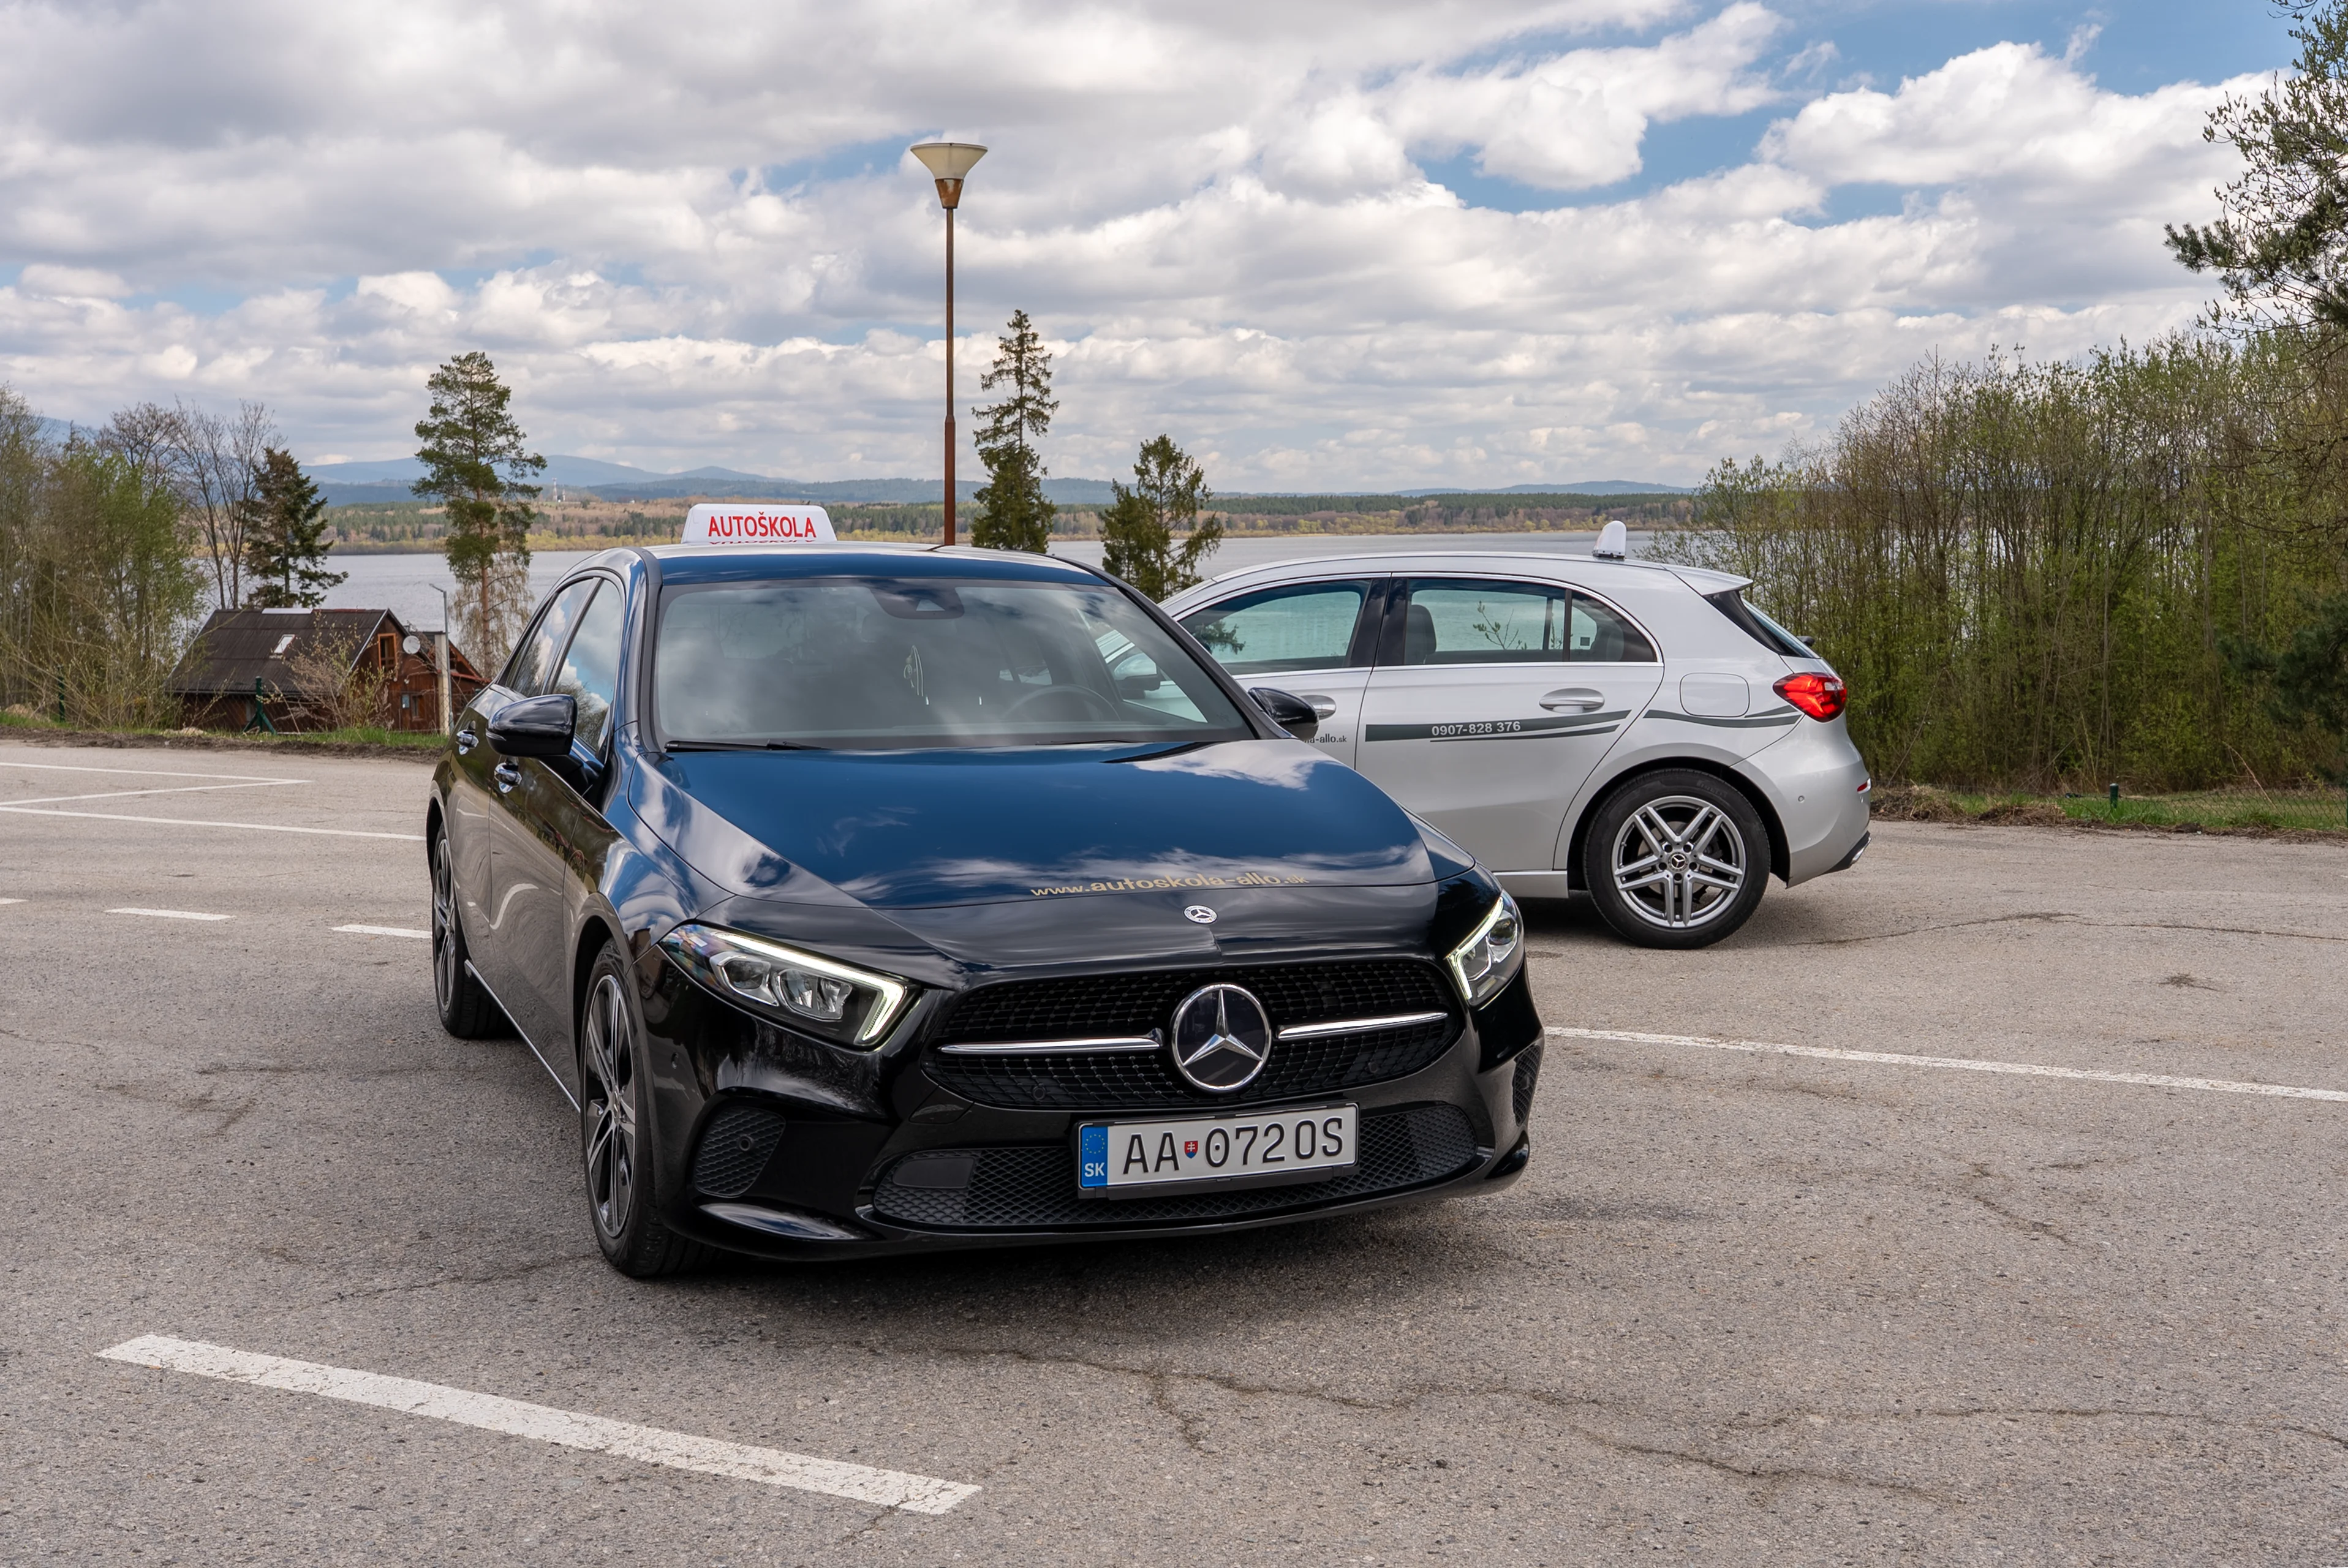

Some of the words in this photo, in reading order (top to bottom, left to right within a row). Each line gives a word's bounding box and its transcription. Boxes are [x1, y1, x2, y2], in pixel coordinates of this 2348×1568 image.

[708, 511, 817, 538] AUTOŠKOLA
[1431, 723, 1492, 736] 0907-828
[1497, 721, 1521, 732] 376
[1305, 733, 1347, 743] a-allo.sk
[1030, 872, 1310, 896] www.autoskola-allo.sk
[1084, 1163, 1105, 1177] SK
